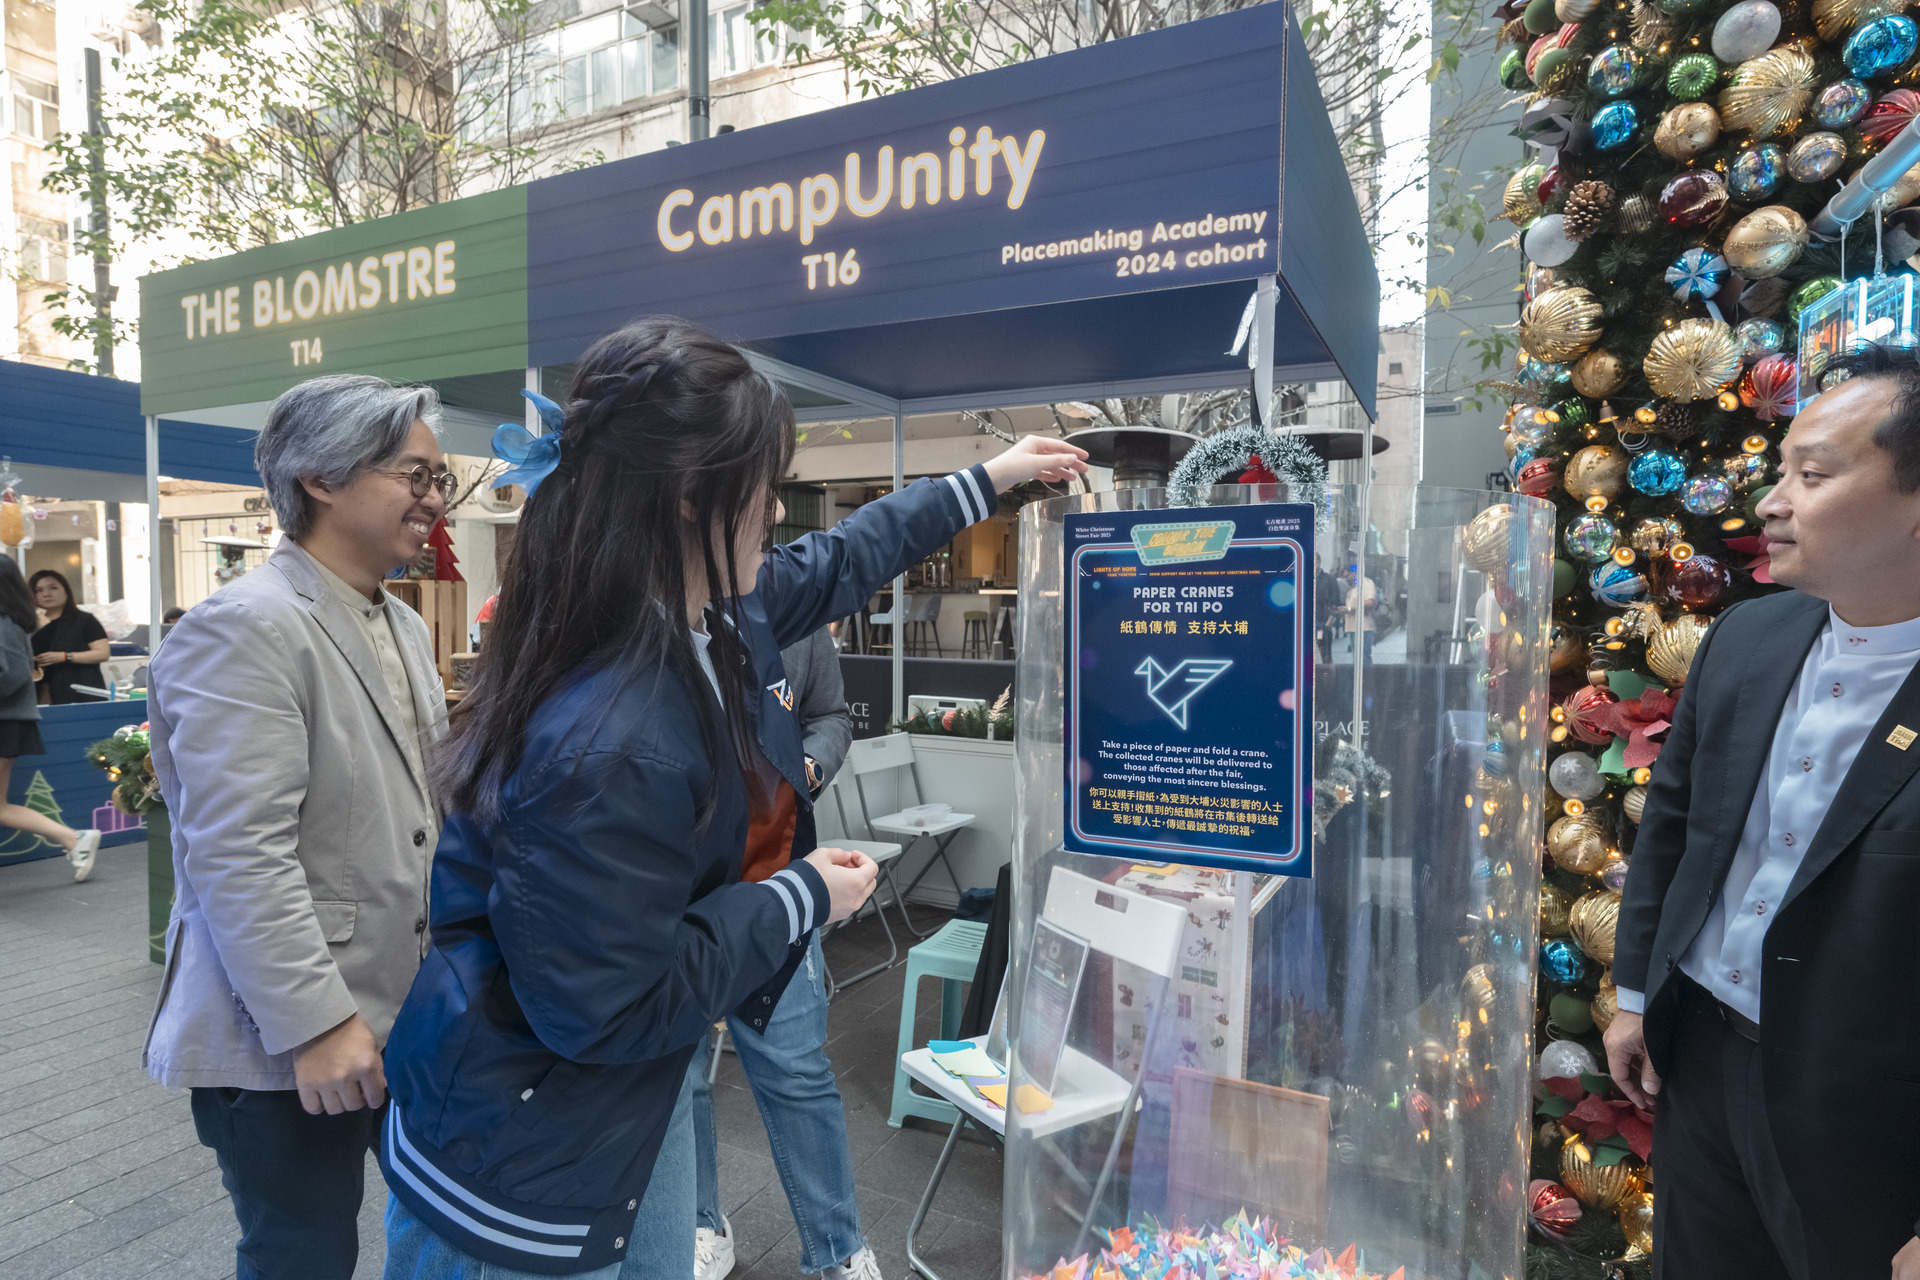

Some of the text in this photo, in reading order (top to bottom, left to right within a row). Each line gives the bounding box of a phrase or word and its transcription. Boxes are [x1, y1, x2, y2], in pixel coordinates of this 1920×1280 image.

[657, 125, 1045, 252] CampUnity
[1002, 211, 1267, 265] Placemaking Academy
[1116, 238, 1267, 277] 2024 cohort
[802, 248, 860, 290] T16
[181, 240, 456, 340] THE BLOMSTRE
[290, 337, 323, 366] T14
[1194, 525, 1220, 540] THE
[1134, 586, 1234, 598] PAPER CRANES
[1143, 602, 1223, 613] FOR TAI PO
[1120, 620, 1248, 635] 紙鶴傳情 支持大埔
[1102, 740, 1121, 748] Take
[1130, 742, 1152, 751] piece
[1165, 746, 1191, 754] paper
[1194, 746, 1210, 754] and
[1212, 746, 1230, 755] fold
[1098, 750, 1113, 759] The
[1115, 752, 1153, 761] collected
[1203, 757, 1214, 765] be
[1217, 758, 1260, 768] delivered
[1124, 763, 1243, 779] those affected after the fair,
[1103, 773, 1145, 783] conveying
[1148, 775, 1162, 783] the
[1187, 778, 1218, 788] sincere
[1221, 780, 1266, 792] blessings.
